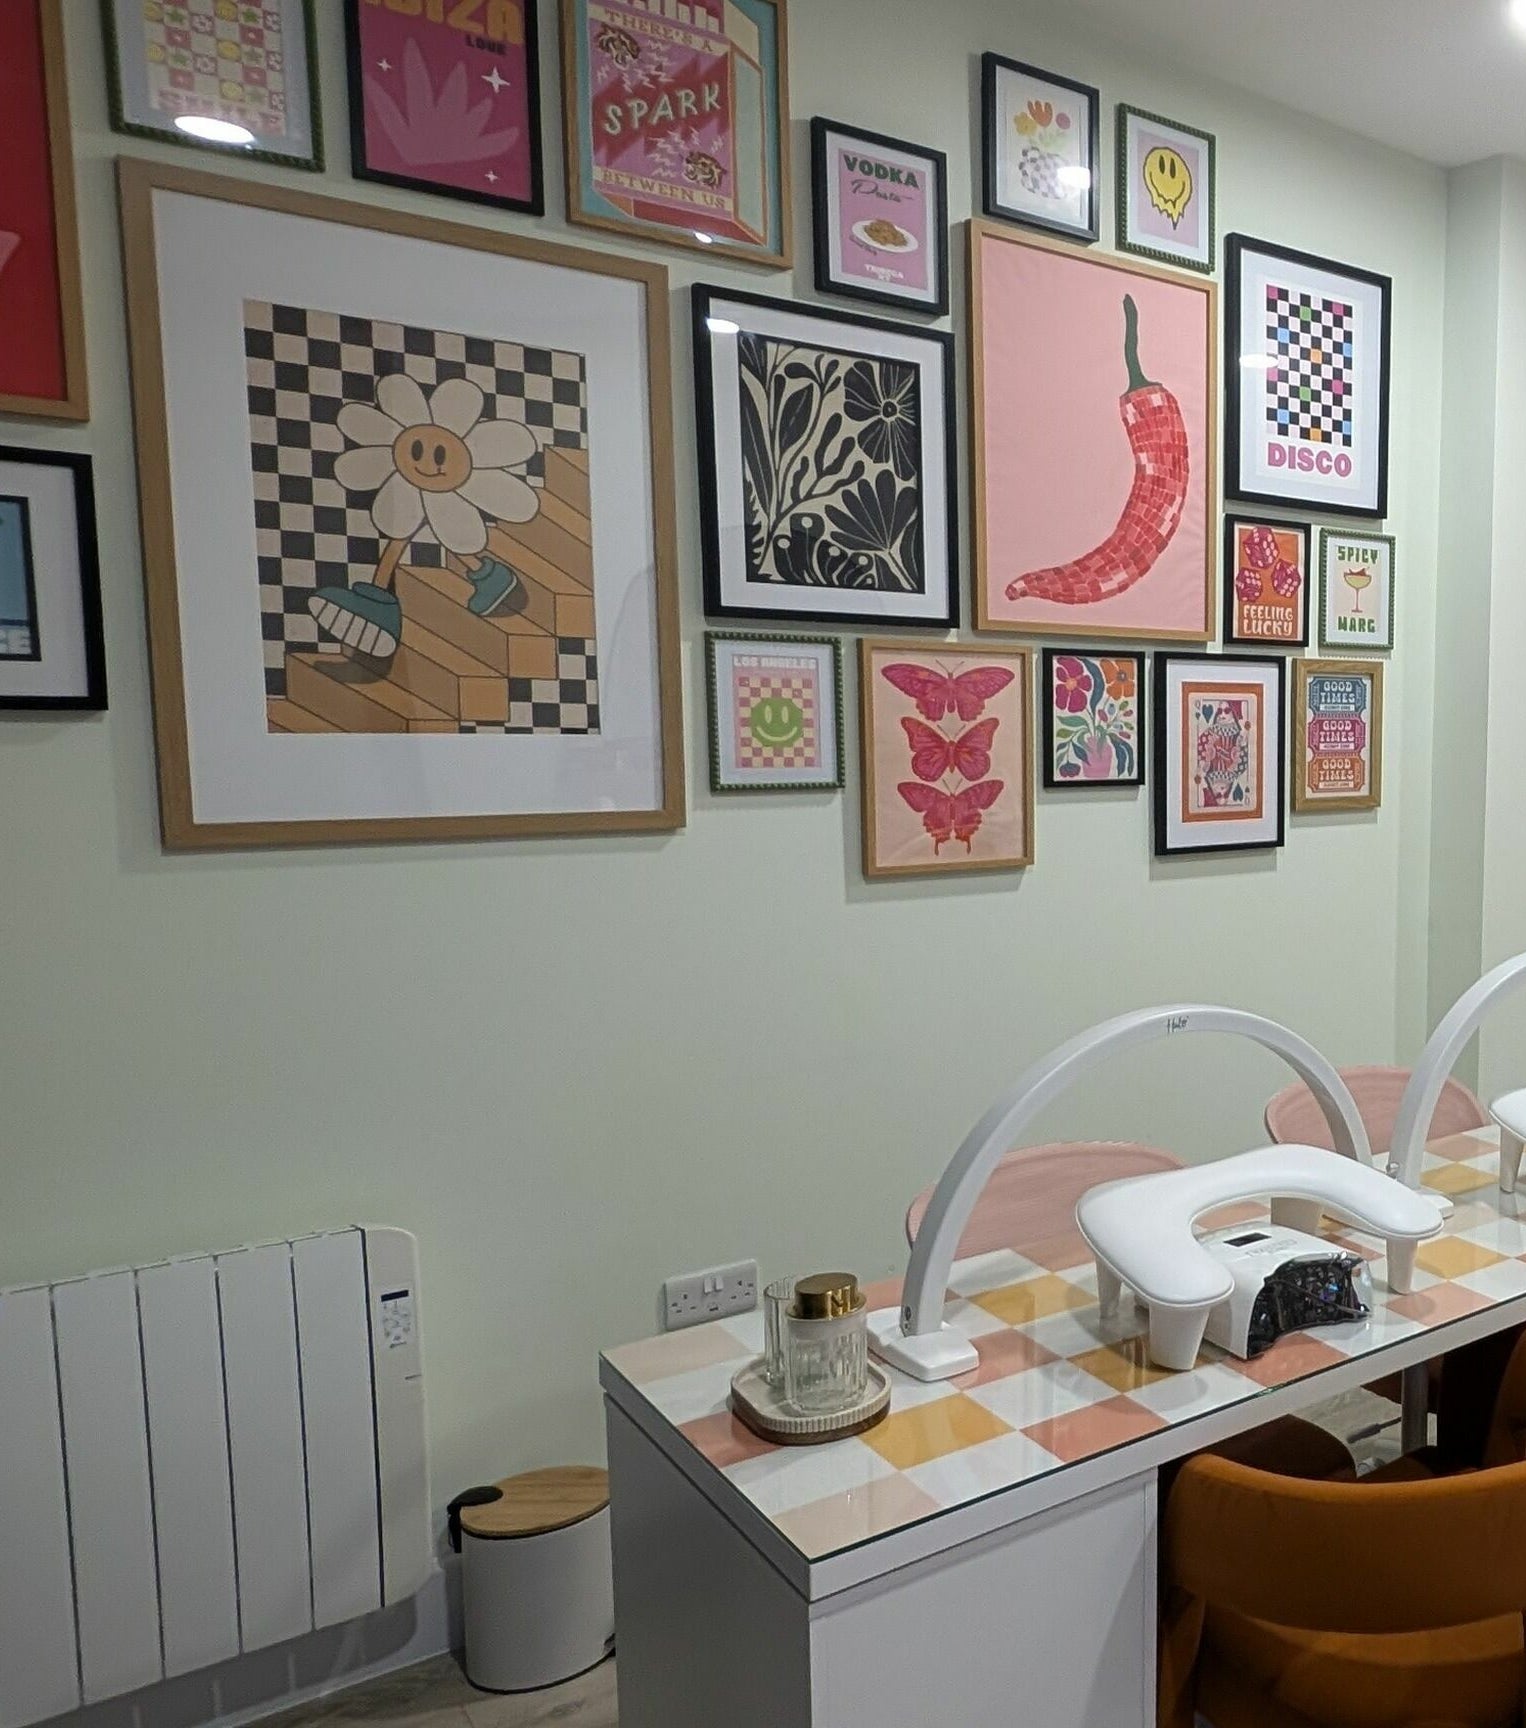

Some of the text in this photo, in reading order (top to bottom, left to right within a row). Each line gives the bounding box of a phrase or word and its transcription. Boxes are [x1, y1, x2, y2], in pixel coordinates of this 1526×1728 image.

[702, 40, 713, 52] A
[604, 84, 720, 136] SPARK
[843, 154, 920, 189] VODKA
[602, 170, 726, 209] BETWEEN US
[1267, 442, 1352, 477] DISCO
[1337, 546, 1378, 564] SPICY
[1243, 604, 1293, 621] FEELING
[1243, 619, 1293, 636] LUCKY
[1337, 616, 1375, 633] MARG
[733, 655, 759, 667] LOS
[1323, 681, 1352, 692] GOOD
[1320, 692, 1355, 703] TIMES
[1322, 720, 1352, 731] GOOD
[1319, 731, 1355, 742] TIMES
[1322, 759, 1351, 769] GOOD
[1319, 770, 1354, 781] TIMES
